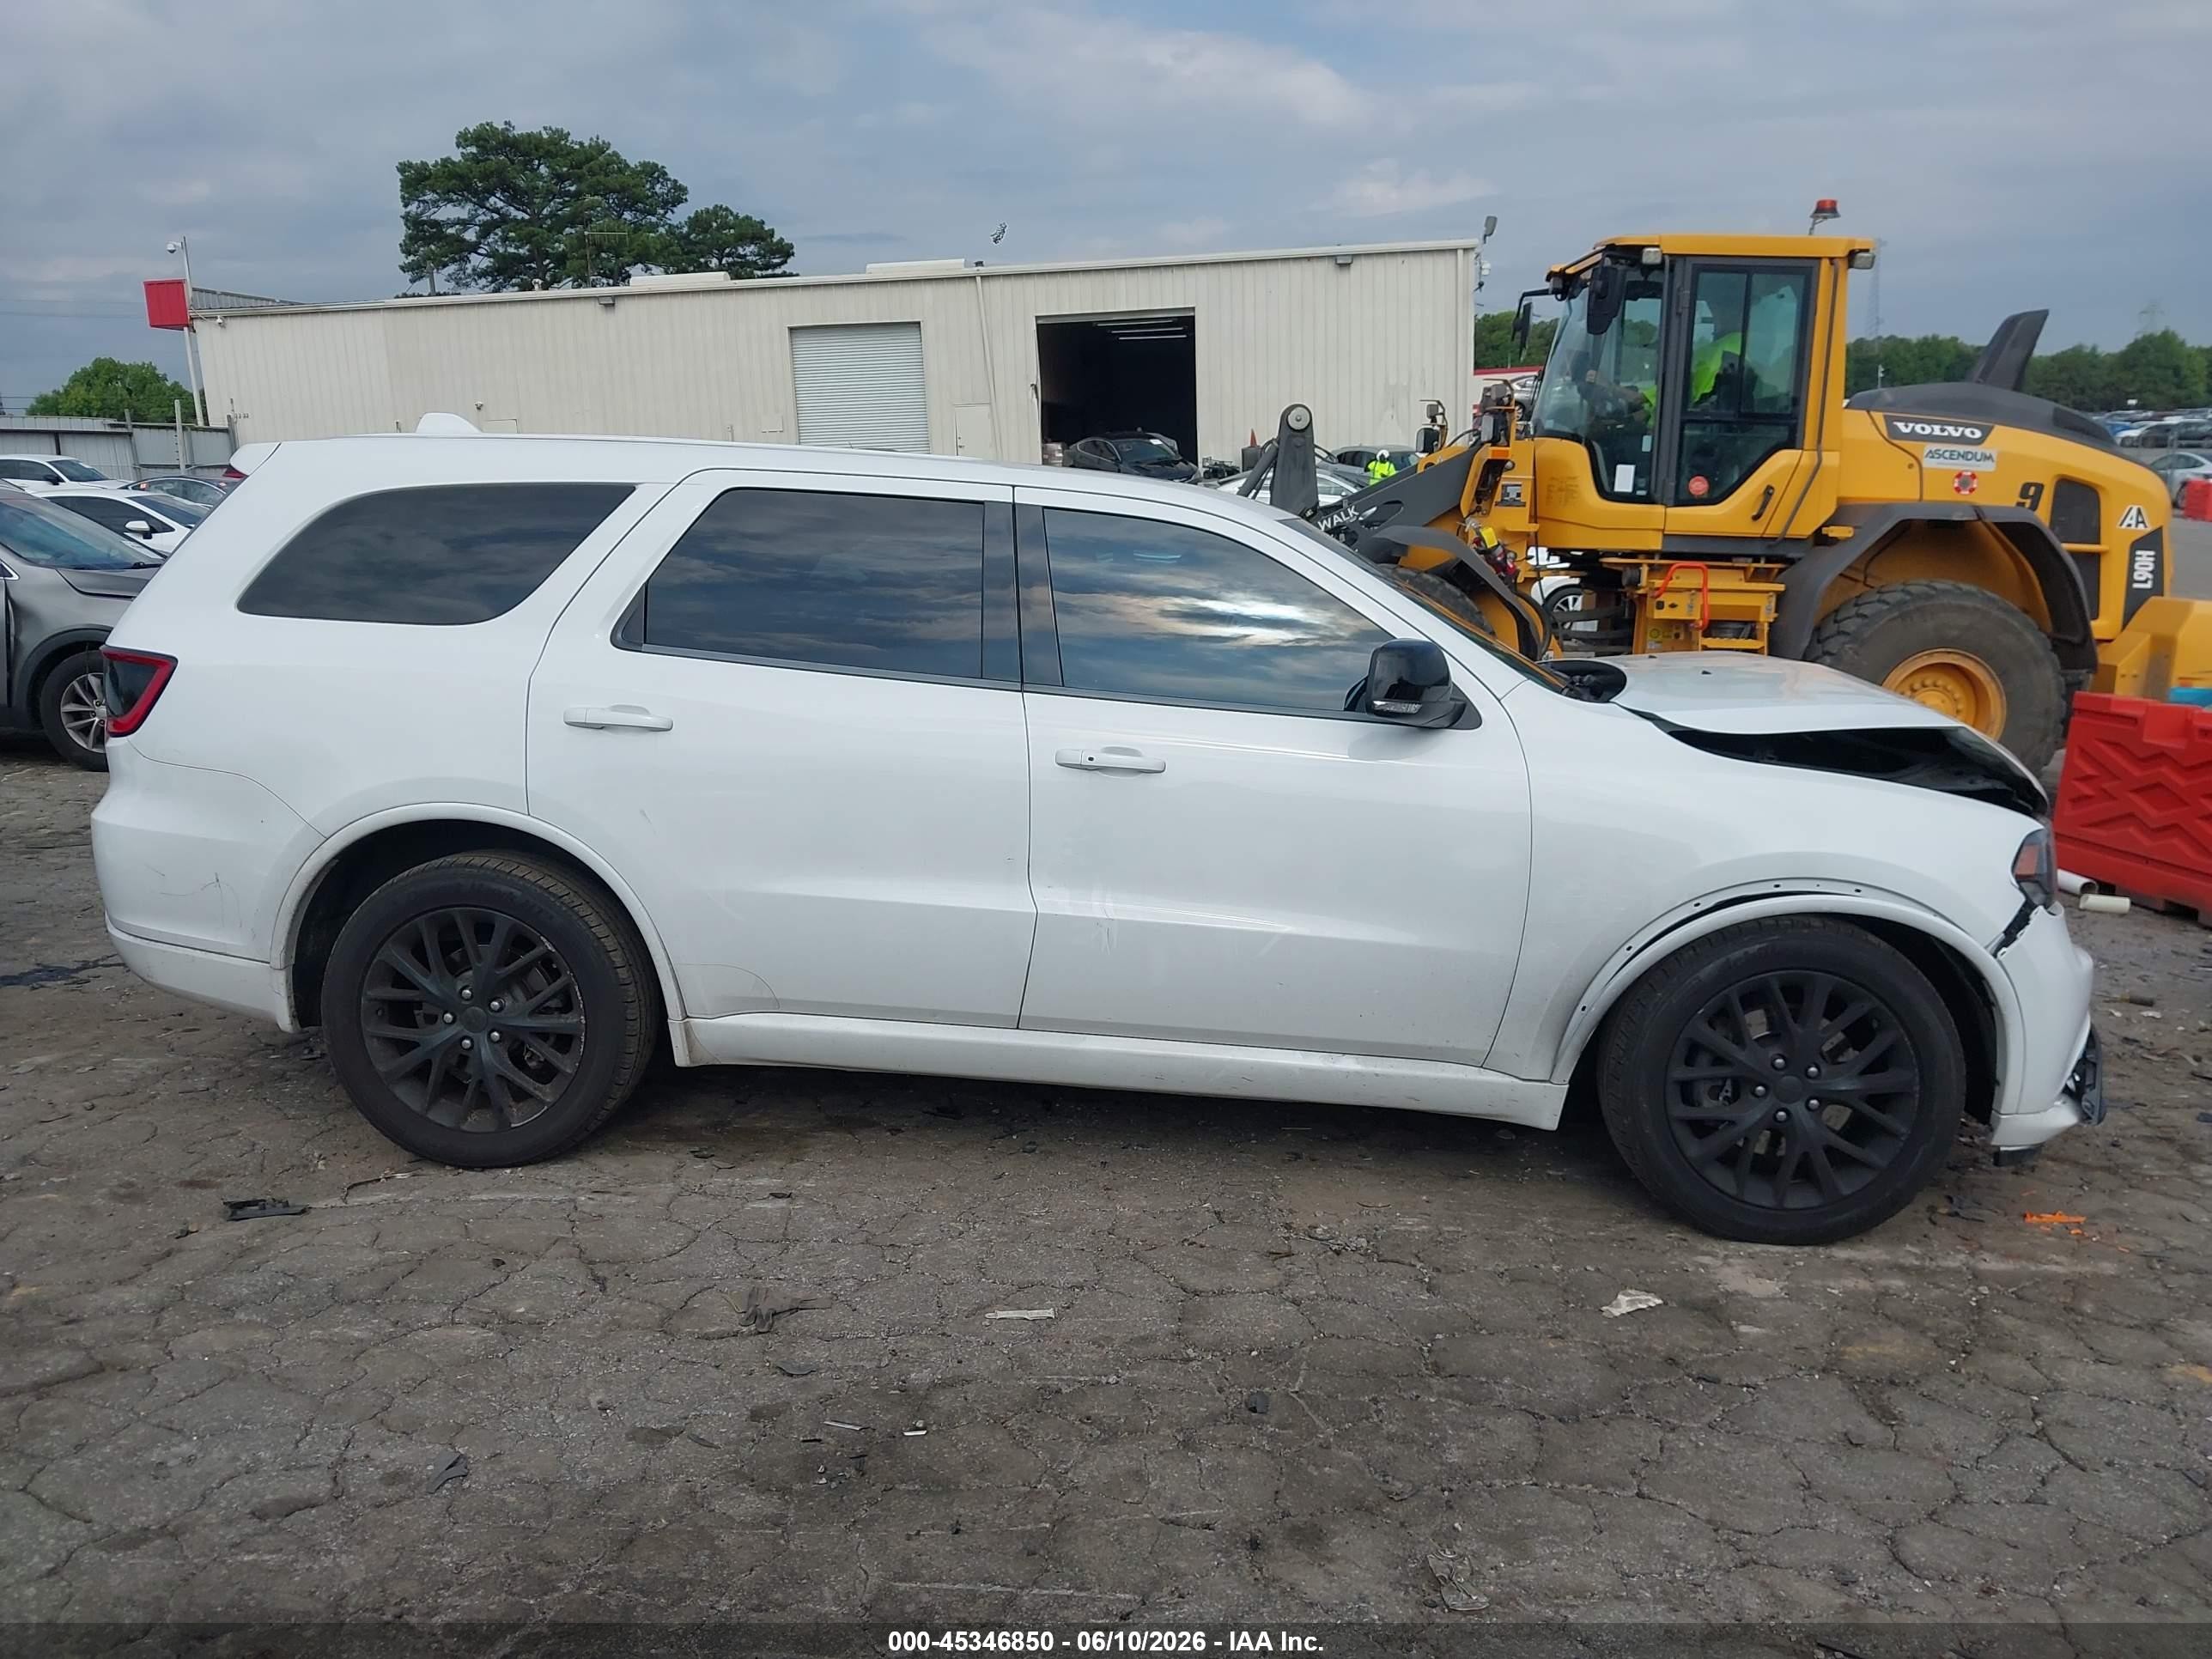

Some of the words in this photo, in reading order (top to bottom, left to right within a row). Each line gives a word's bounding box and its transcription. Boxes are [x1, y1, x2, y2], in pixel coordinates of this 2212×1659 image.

[1893, 422, 1983, 440] VOLVO
[1924, 448, 1995, 463] ASCENDUM
[2015, 483, 2045, 512] 9
[1317, 505, 1360, 532] WALK
[2132, 550, 2156, 589] L90H
